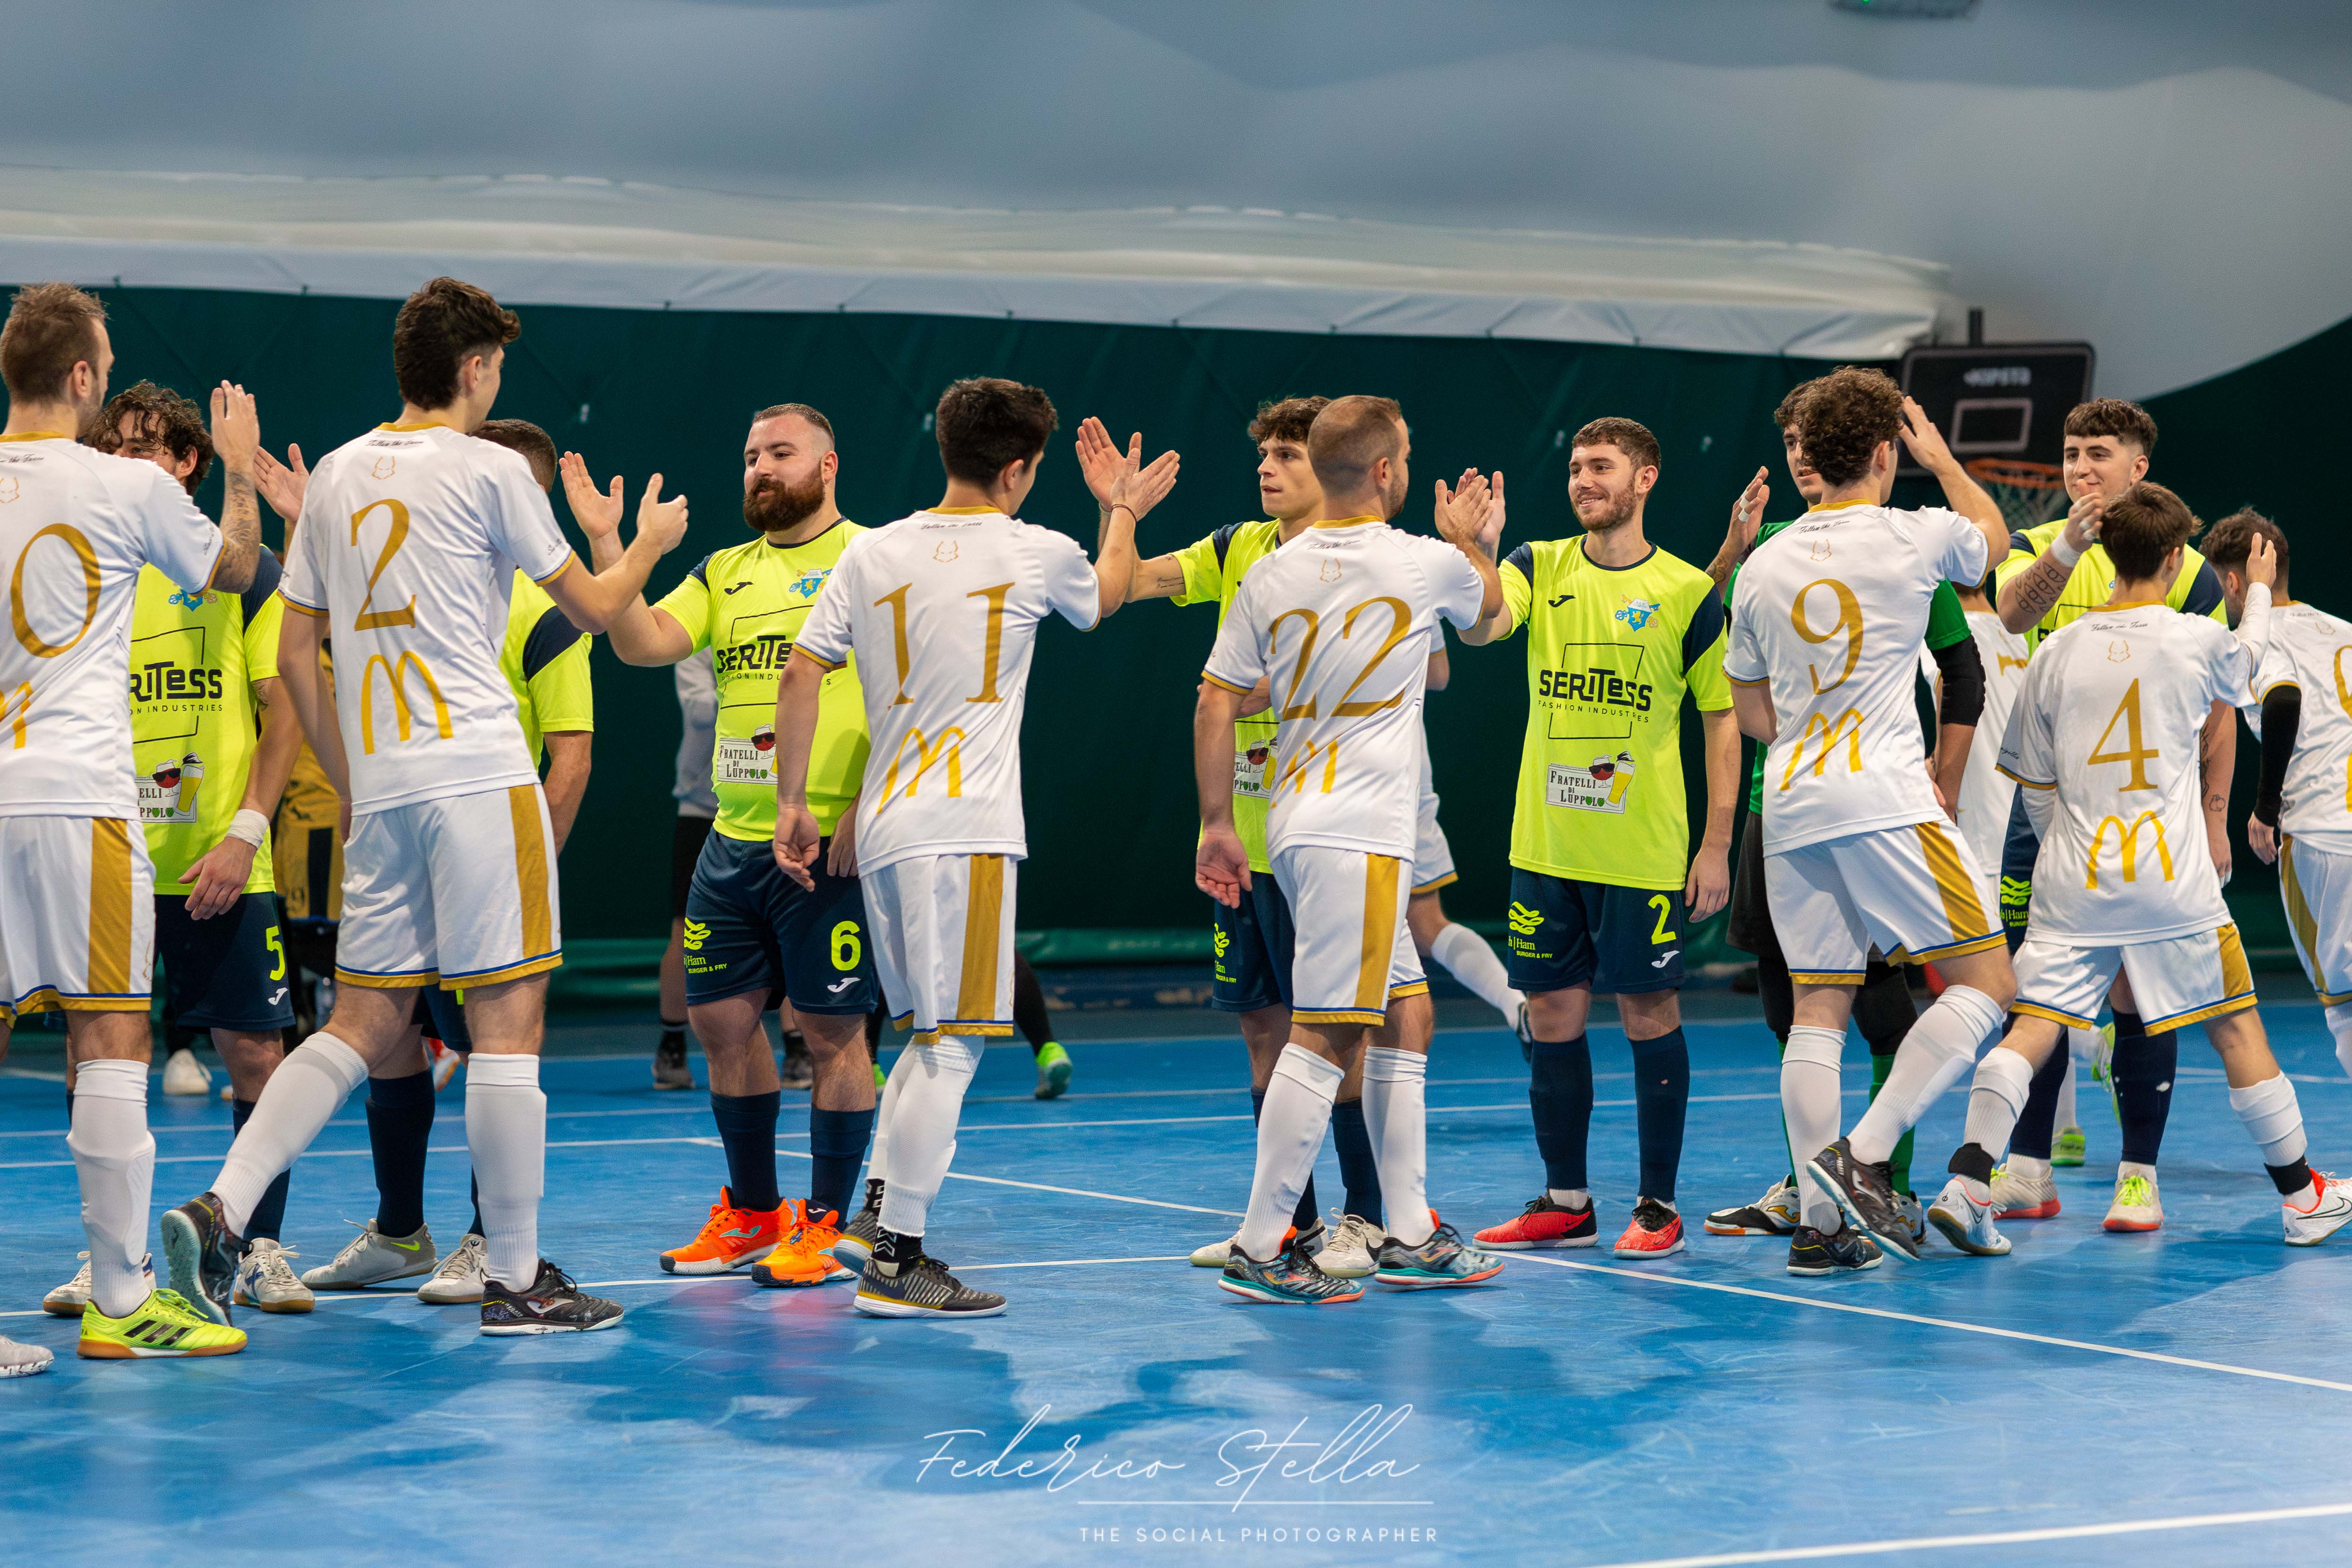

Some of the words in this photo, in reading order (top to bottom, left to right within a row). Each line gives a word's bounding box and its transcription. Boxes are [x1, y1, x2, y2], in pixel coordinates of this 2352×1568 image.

[10, 523, 101, 658] 0
[351, 499, 416, 631] 2
[874, 582, 1015, 710] 11
[1268, 596, 1412, 722] 22
[1791, 578, 1864, 695] 9
[1538, 701, 1583, 712] FASHION
[719, 745, 758, 760] FRATELLI
[2087, 677, 2159, 792] 4
[139, 788, 162, 798] ELLI
[1550, 770, 1596, 789] FRATELLI
[831, 920, 861, 971] 6
[1648, 894, 1677, 945] 2
[265, 925, 286, 981] 5
[1516, 950, 1536, 958] BURGER
